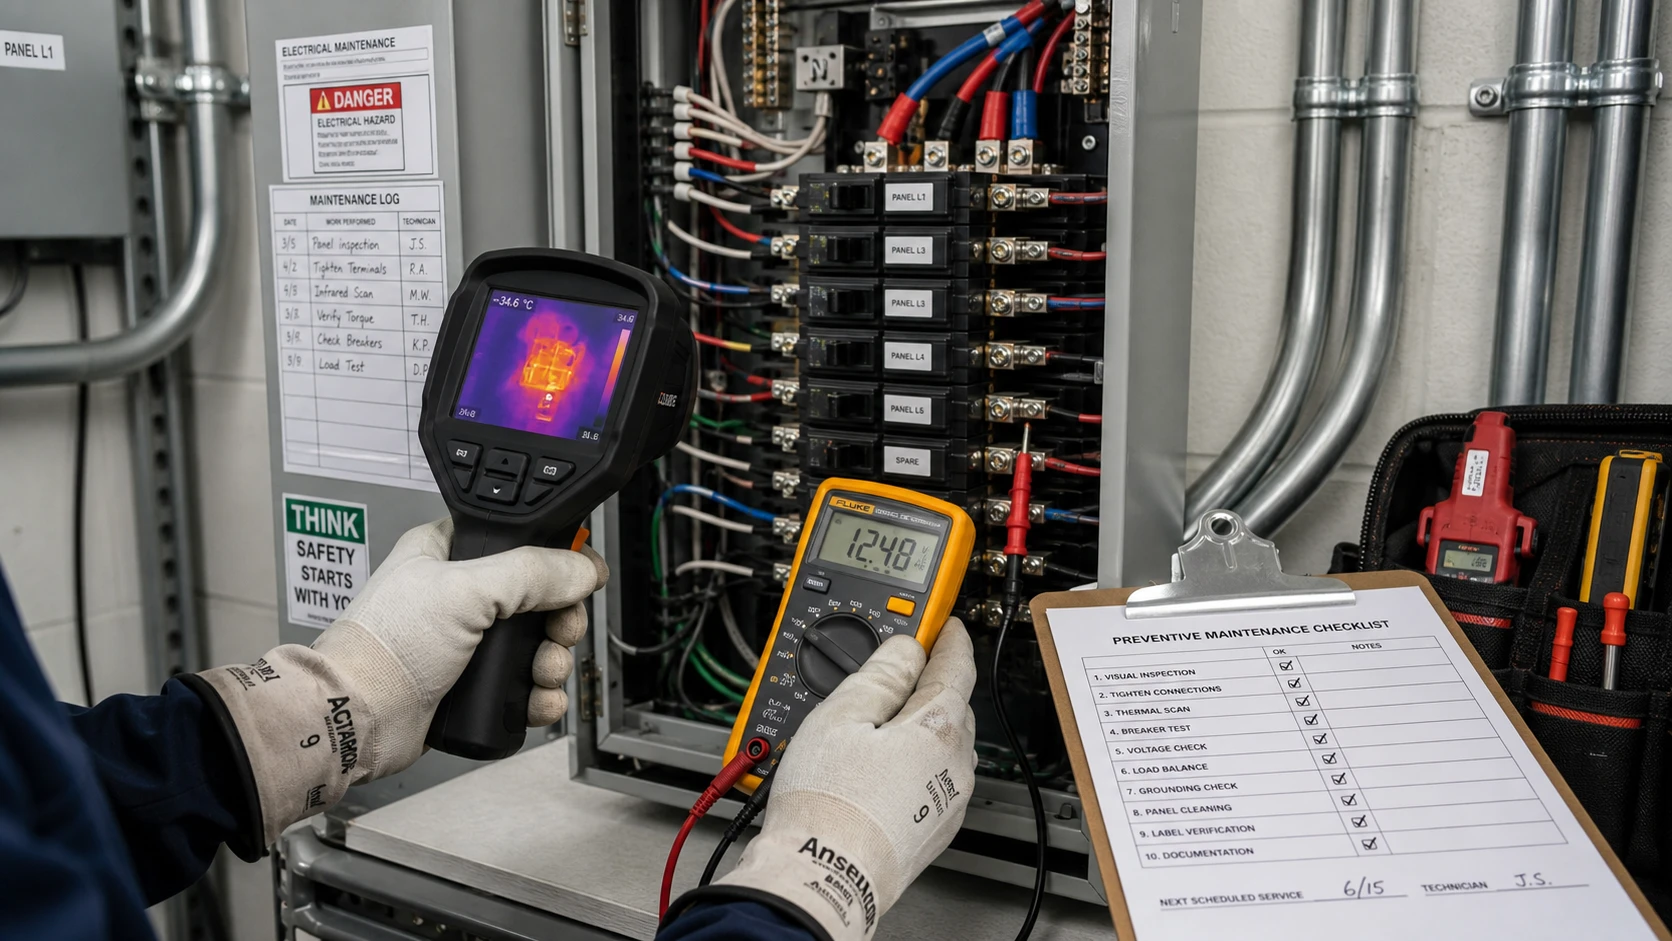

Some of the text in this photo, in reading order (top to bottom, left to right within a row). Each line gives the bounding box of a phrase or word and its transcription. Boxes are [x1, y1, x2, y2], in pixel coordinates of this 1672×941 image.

[4, 41, 54, 59] PANEL L1
[282, 37, 396, 57] ELECTRICAL MAINTENANCE
[334, 88, 394, 109] DANGER
[317, 114, 395, 128] ELECTRICAL HAZARD
[310, 193, 400, 206] MAINTENANCE LOG
[892, 193, 916, 201] PANEL
[284, 218, 297, 226] DATE
[326, 218, 376, 226] WORK PERFORMED
[312, 236, 380, 255] Panel inspection
[408, 238, 427, 250] J.S.
[891, 246, 915, 254] PANEL
[313, 260, 387, 279] Tighten Terminals
[409, 262, 428, 275] R.A.
[314, 283, 374, 299] Infrared Scan
[891, 299, 915, 307] PANEL
[316, 310, 375, 329] Verify Torque
[411, 314, 430, 326] T.H.
[317, 332, 383, 349] Check Breakers
[891, 352, 915, 361] PANEL
[318, 358, 365, 373] Load Test
[890, 405, 914, 414] PANEL
[895, 456, 920, 466] SPARE
[835, 499, 871, 512] FLUKE
[290, 503, 360, 539] THINK
[297, 539, 355, 566] SAFETY
[847, 528, 917, 571] 12.48
[301, 565, 353, 589] STARTS
[294, 586, 355, 611] WITH YO
[1112, 620, 1390, 645] PREVENTIVE MAINTENANCE CHECKLIST
[1105, 672, 1138, 680] VISUAL
[1140, 669, 1196, 678] INSPECTION
[1110, 689, 1151, 698] TIGHTEN
[1153, 685, 1222, 696] CONNECTIONS
[1115, 707, 1162, 716] THERMAL
[1164, 706, 1191, 714] SCAN
[1121, 726, 1166, 735] BREAKER
[300, 734, 320, 749] 9
[1127, 745, 1171, 754] VOLTAGE
[1174, 743, 1208, 752] CHECK
[1132, 766, 1160, 774] LOAD
[1162, 763, 1208, 773] BALANCE
[1138, 785, 1201, 795] GROUNDING
[1203, 782, 1238, 791] CHECK
[913, 804, 930, 823] 9
[1145, 807, 1178, 816] PANEL
[1180, 804, 1233, 814] CLEANING
[1139, 825, 1256, 838] 9. LABEL VERIFICATION
[1145, 847, 1254, 861] 10. DOCUMENTATION
[1421, 881, 1489, 892] TECHNICIAN
[1513, 872, 1553, 888] J.S.
[1343, 876, 1384, 899] 6/15
[1159, 890, 1304, 907] NEXT SCHEDULED SERVICE
